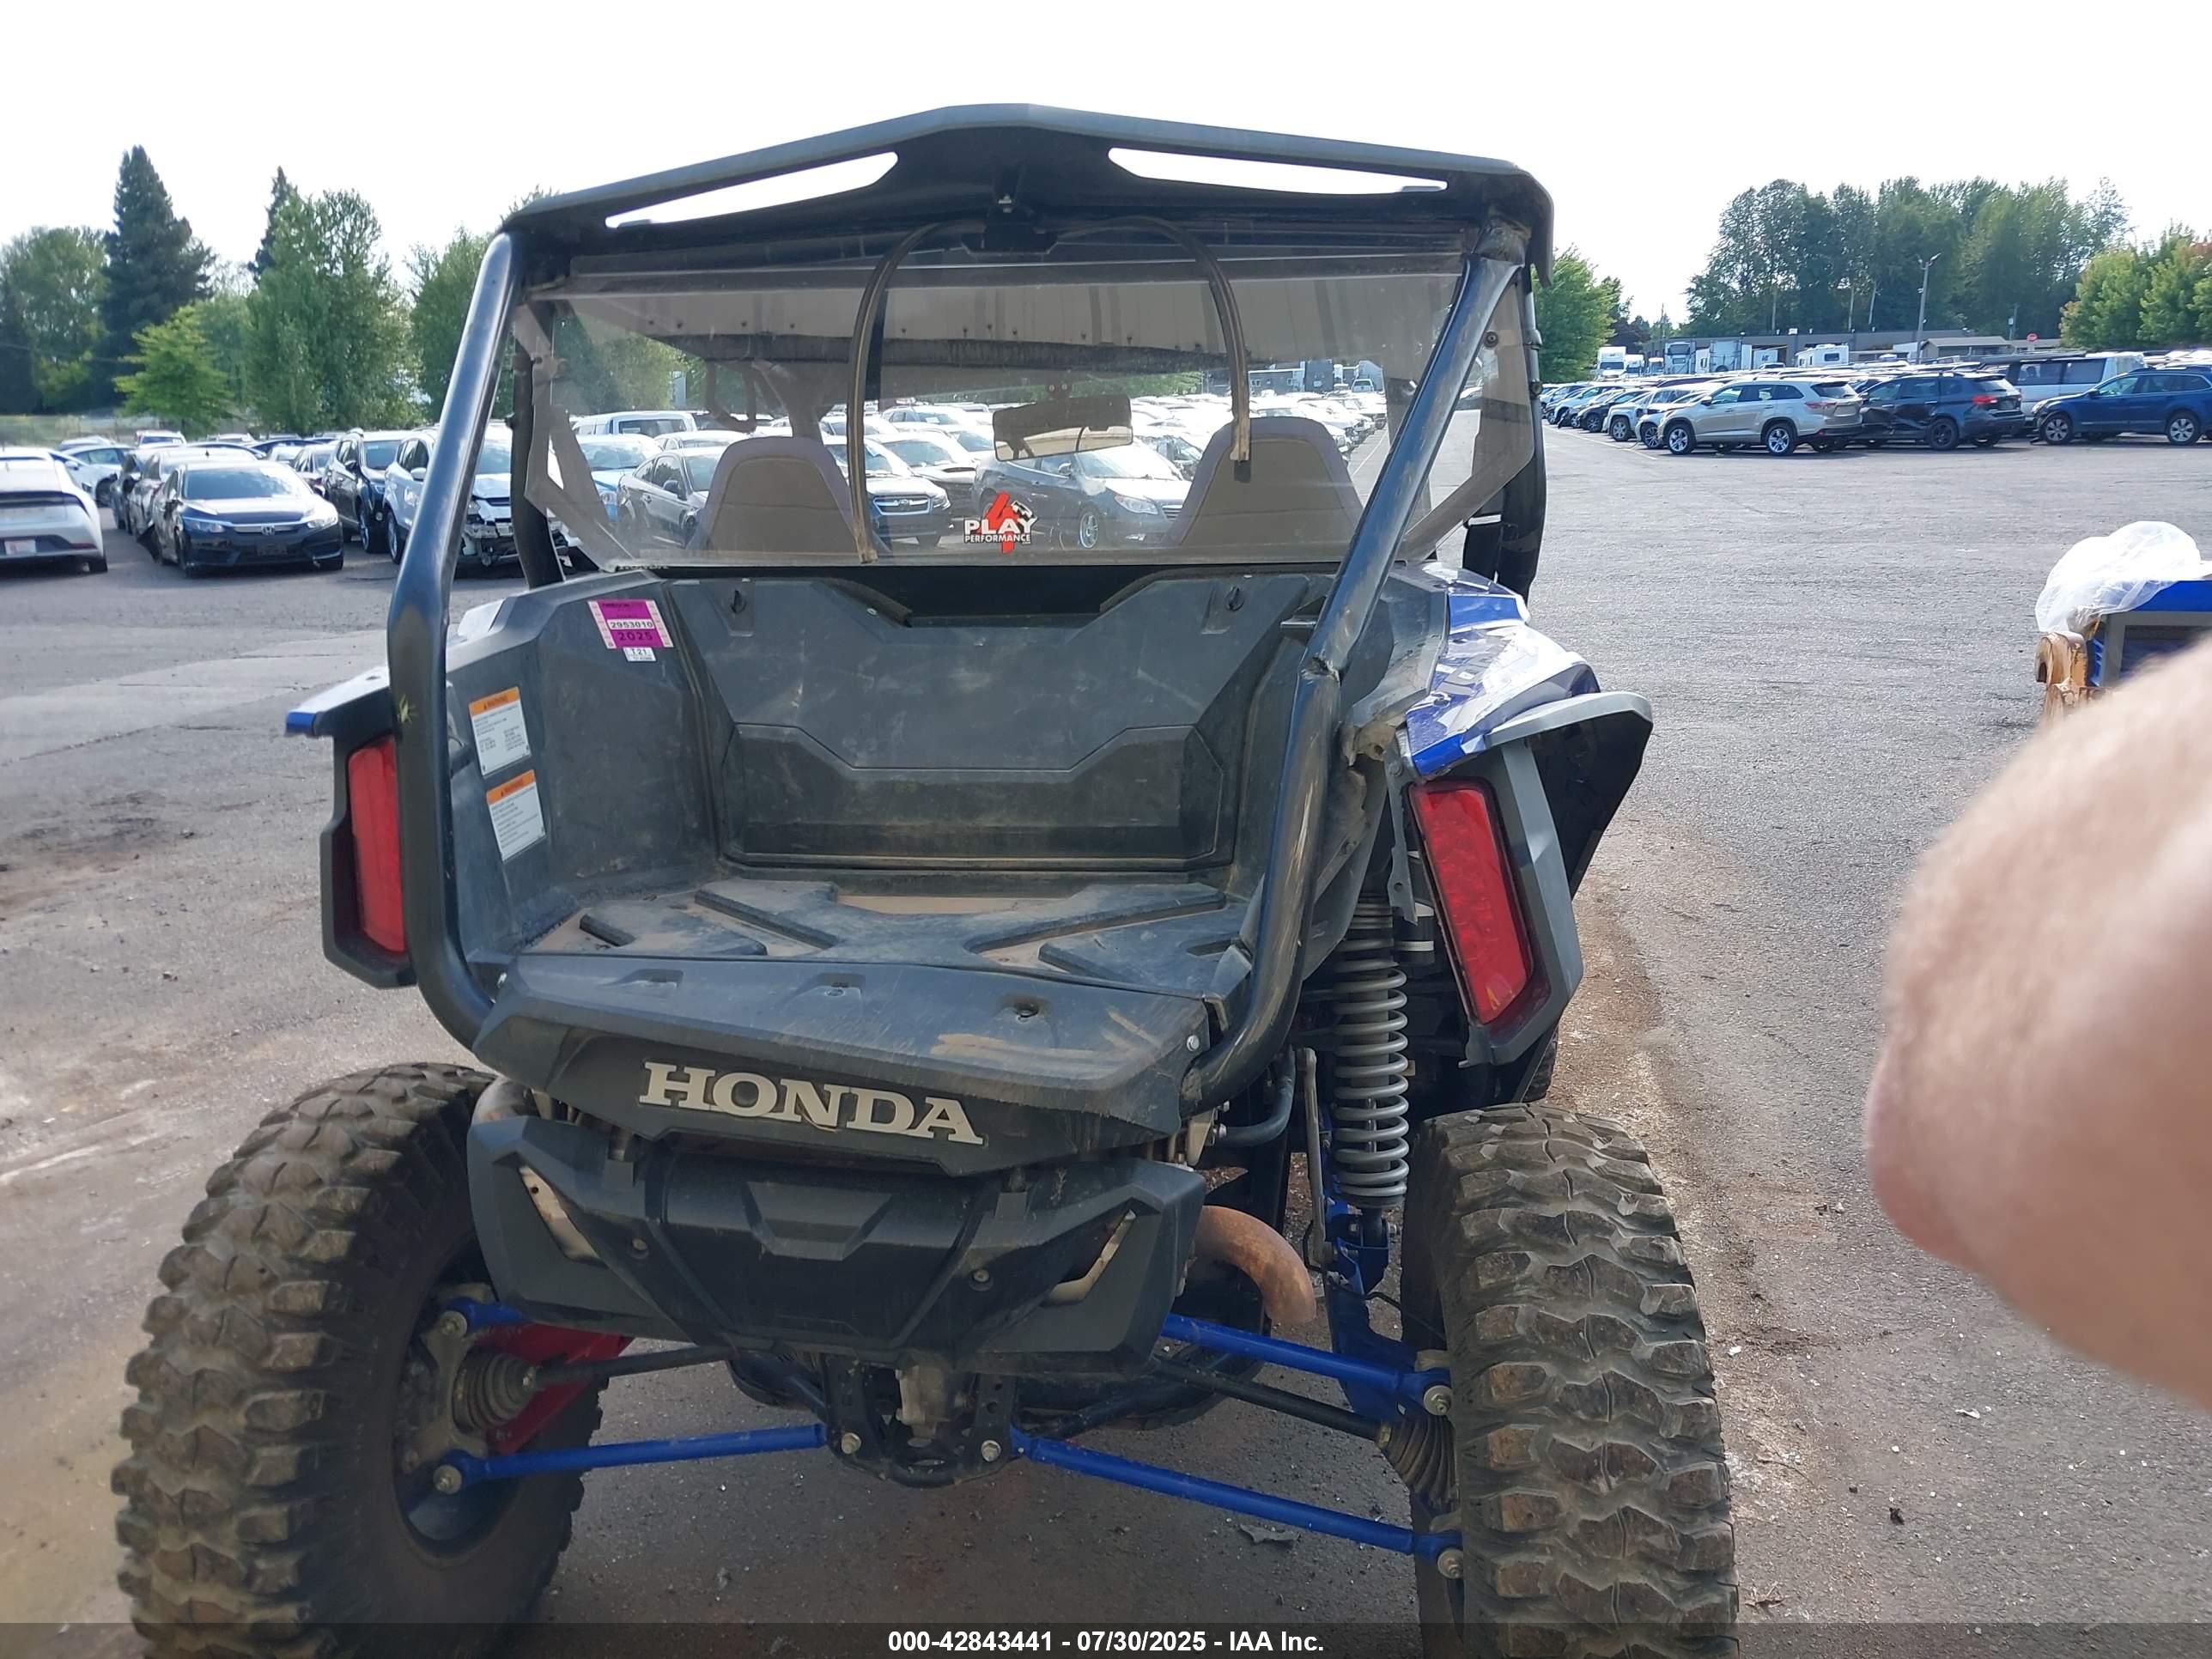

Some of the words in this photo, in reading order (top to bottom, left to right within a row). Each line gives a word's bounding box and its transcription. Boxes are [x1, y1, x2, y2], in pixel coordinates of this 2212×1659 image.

[964, 518, 1037, 534] PLAY
[964, 534, 1031, 543] PERFORMANCE
[618, 632, 653, 641] 2025
[639, 1061, 984, 1145] HONDA
